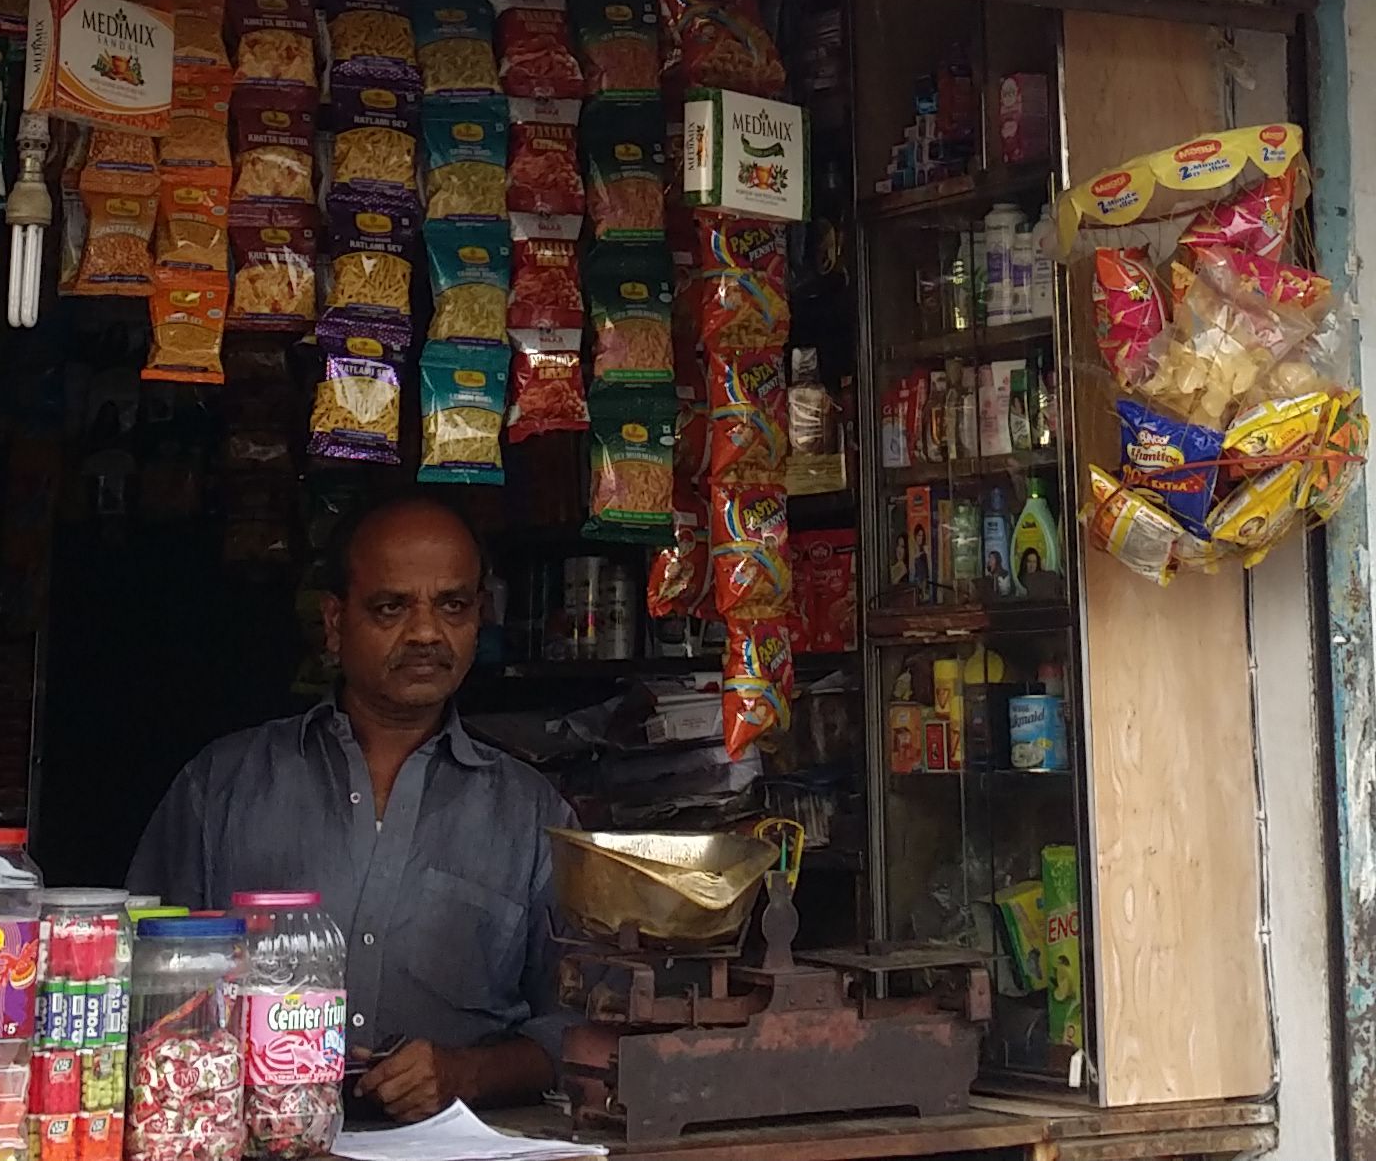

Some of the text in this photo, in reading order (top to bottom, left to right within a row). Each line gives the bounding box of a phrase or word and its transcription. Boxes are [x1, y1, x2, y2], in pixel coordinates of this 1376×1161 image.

[730, 227, 770, 255] PASTA
[741, 362, 774, 391] PASTA
[743, 498, 778, 526] PASTA
[86, 997, 99, 1037] POLO
[268, 1002, 321, 1030] Center
